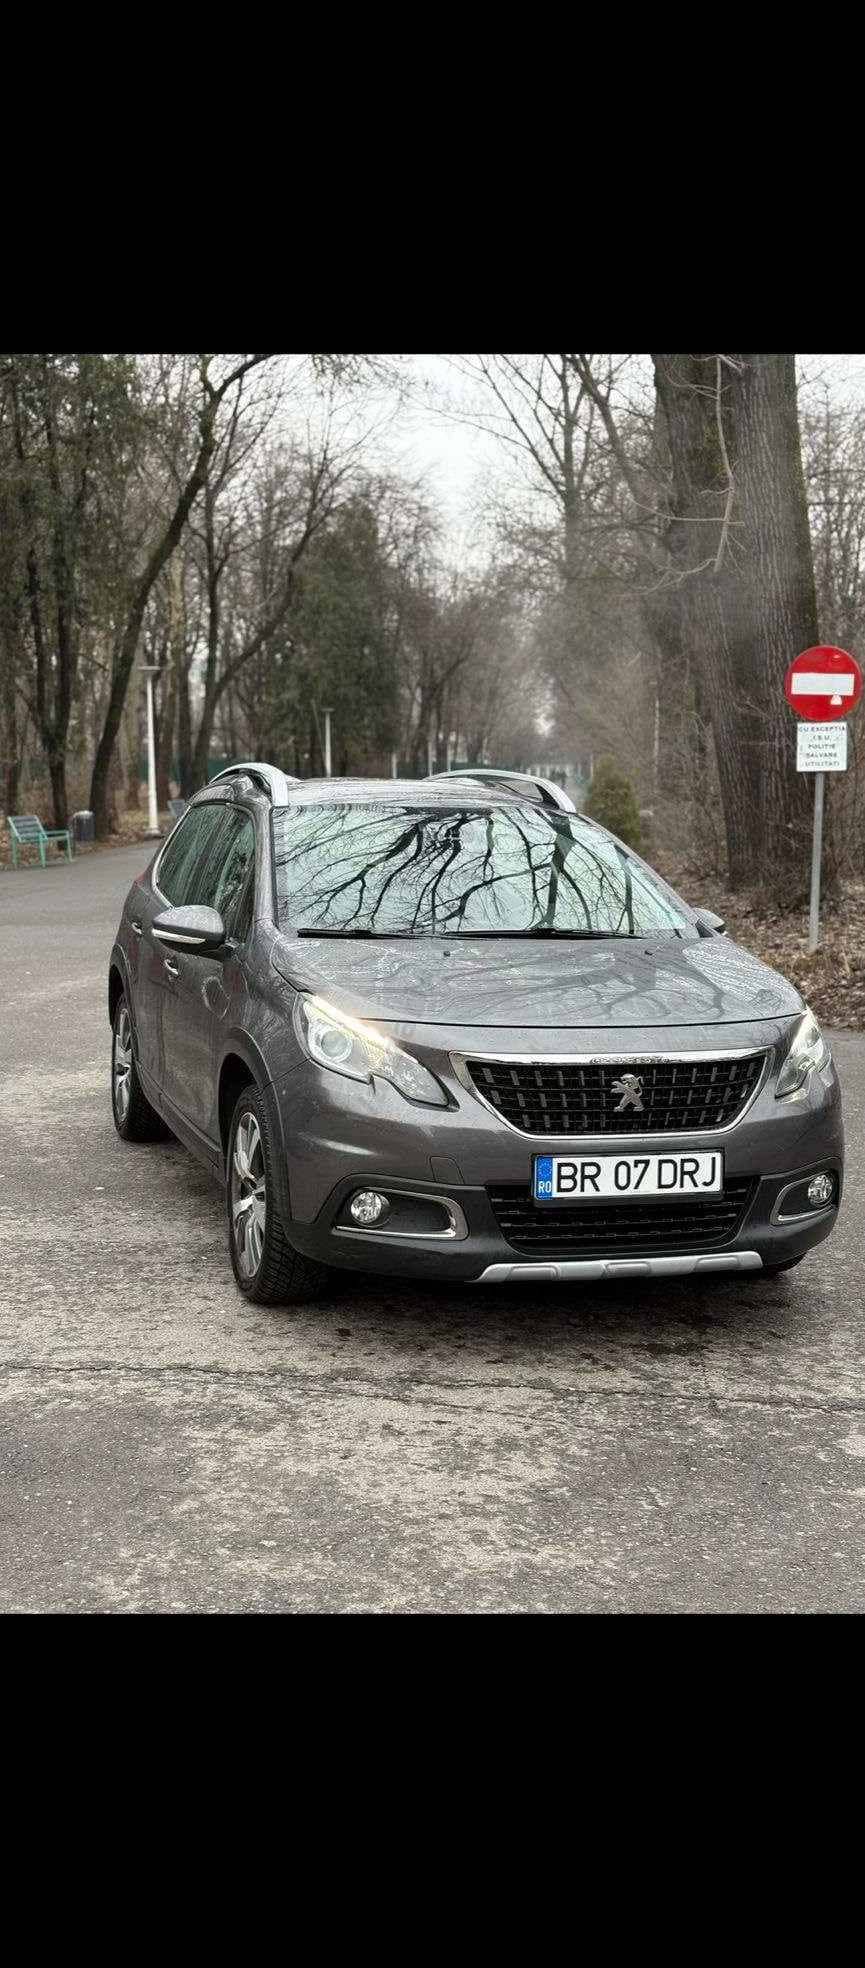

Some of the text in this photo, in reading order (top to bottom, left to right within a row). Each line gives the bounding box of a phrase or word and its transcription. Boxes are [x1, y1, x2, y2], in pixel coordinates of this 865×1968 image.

[538, 1180, 552, 1193] RO
[556, 1156, 716, 1193] BR 07 DRJ
